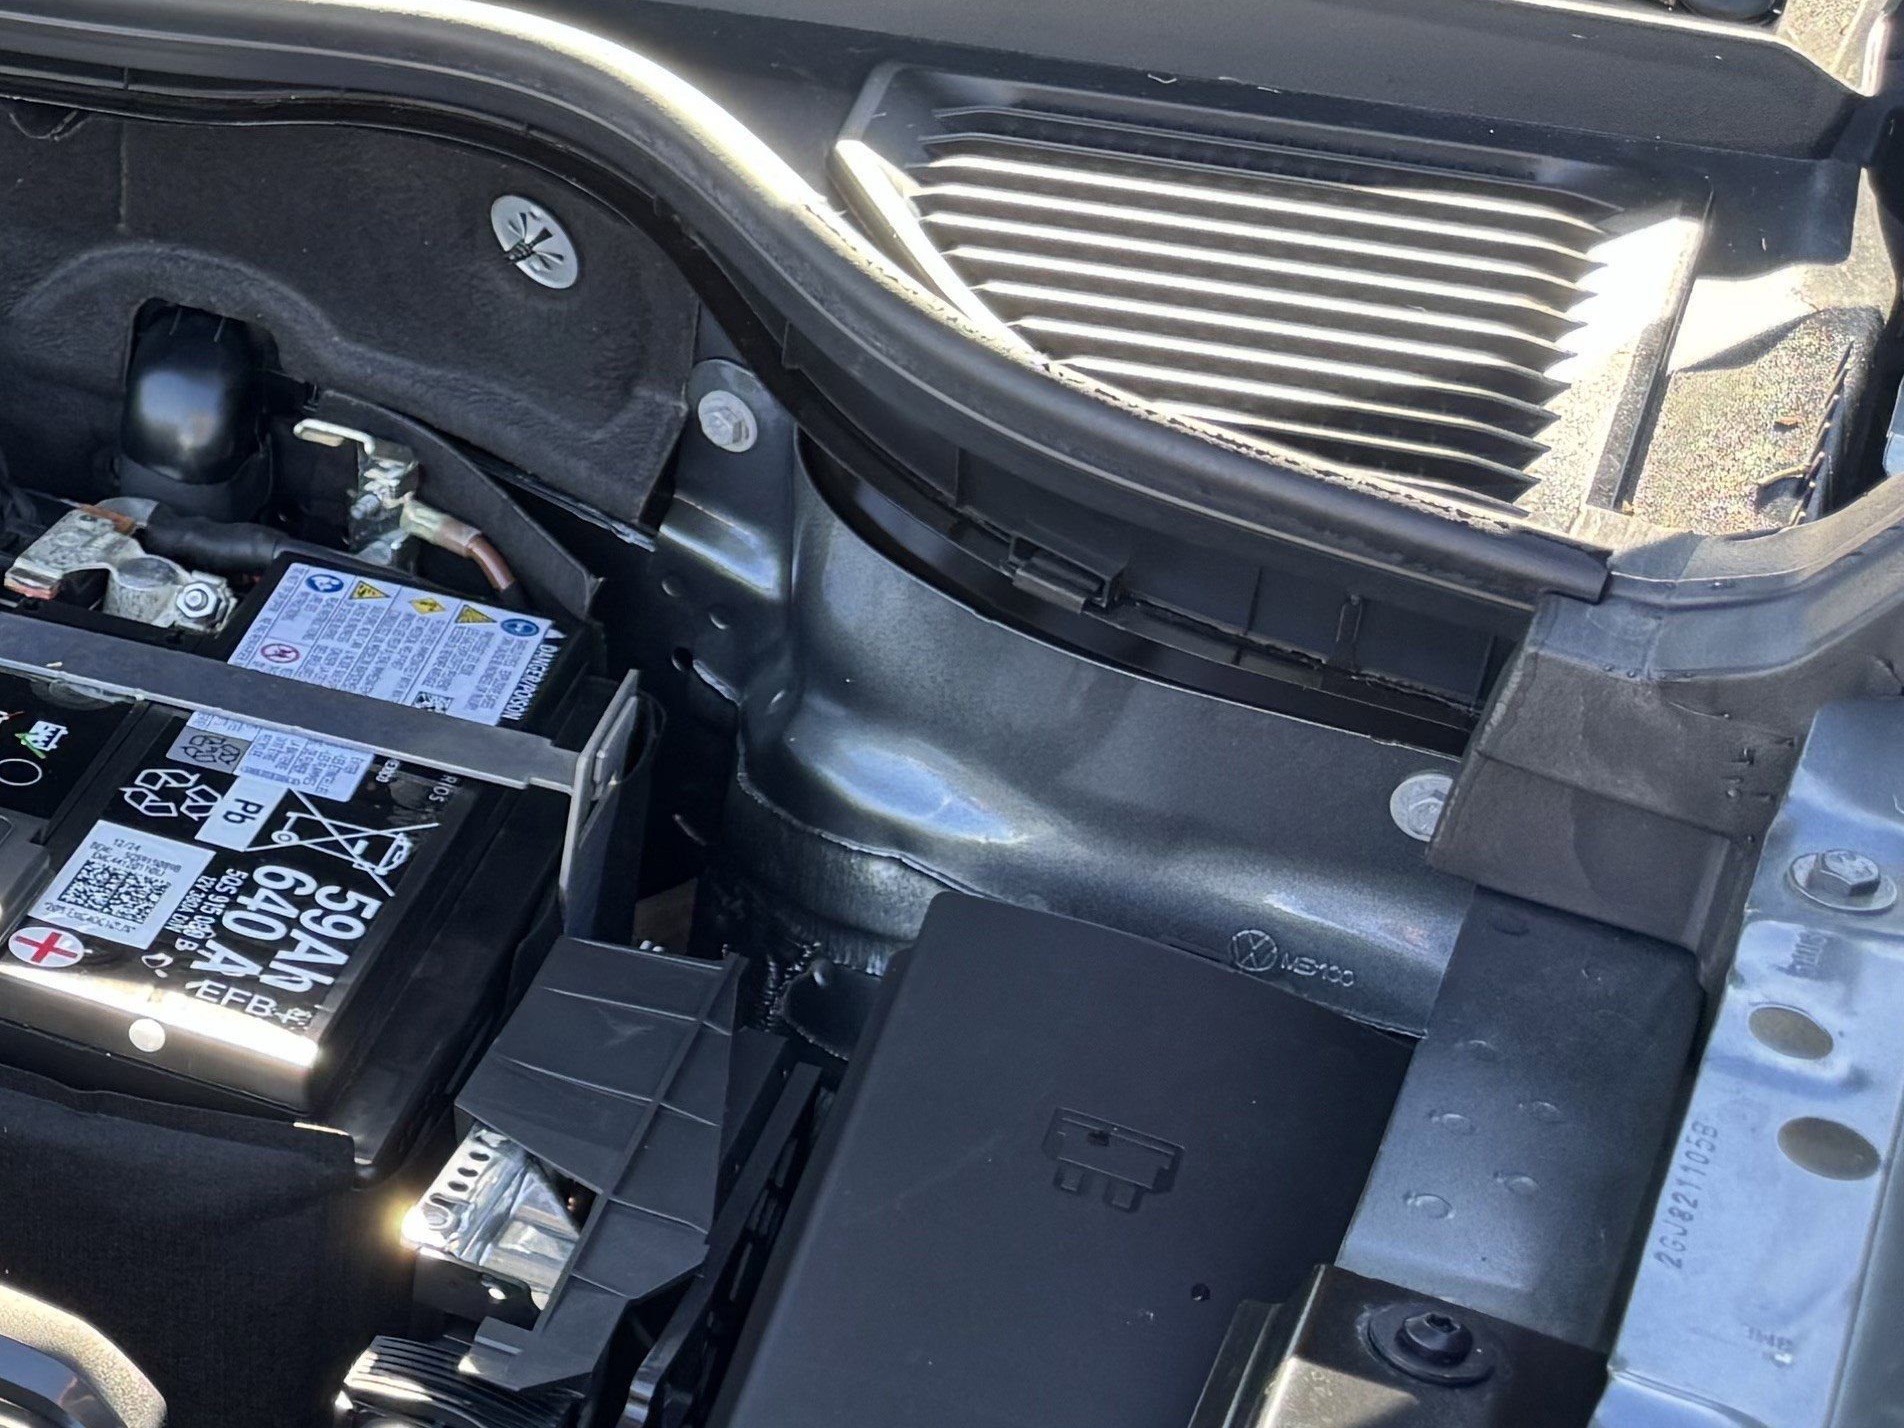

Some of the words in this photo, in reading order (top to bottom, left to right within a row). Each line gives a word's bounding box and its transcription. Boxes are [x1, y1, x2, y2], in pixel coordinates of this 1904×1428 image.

[222, 798, 262, 824] Pb
[222, 865, 318, 941] 640
[191, 939, 264, 977] A
[260, 884, 383, 993] 59Ah
